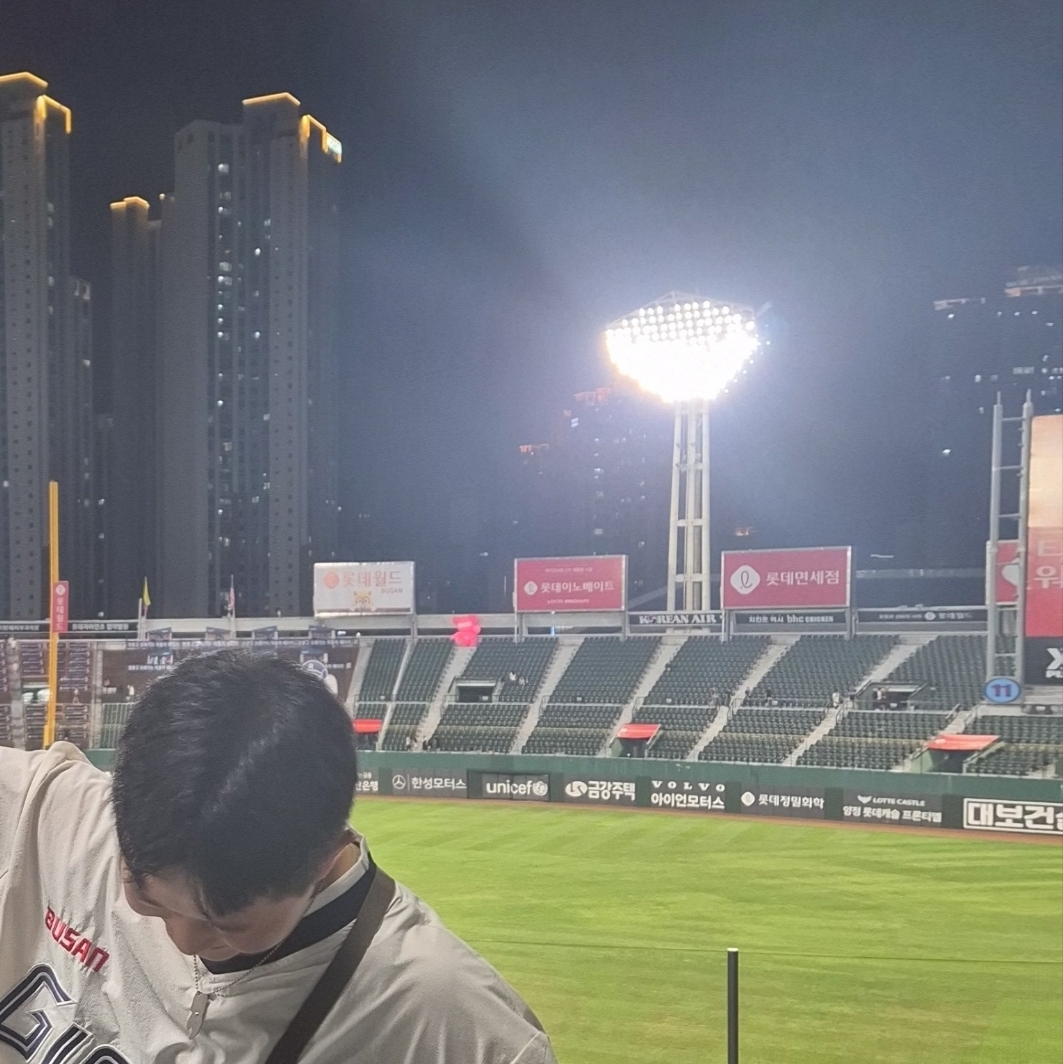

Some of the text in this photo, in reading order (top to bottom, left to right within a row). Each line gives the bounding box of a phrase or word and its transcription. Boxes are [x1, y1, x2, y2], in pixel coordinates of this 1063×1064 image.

[343, 570, 403, 587] 롯데월드
[766, 570, 840, 586] 롯데면세점
[541, 581, 615, 593] 롯데이노베이트
[692, 614, 716, 623] AIR
[787, 614, 804, 623] bhc
[411, 776, 467, 790] 한성모터스
[486, 780, 533, 795] unicef
[651, 780, 725, 792] VOLVO
[588, 781, 635, 801] 금강주택
[651, 793, 725, 809] 아이언모터스
[758, 793, 825, 809] 롯데정밀화학
[896, 799, 926, 807] CASTLE
[863, 806, 900, 820] 롯데캐슬
[968, 803, 1063, 830] 대보건
[43, 905, 110, 973] BUSAN
